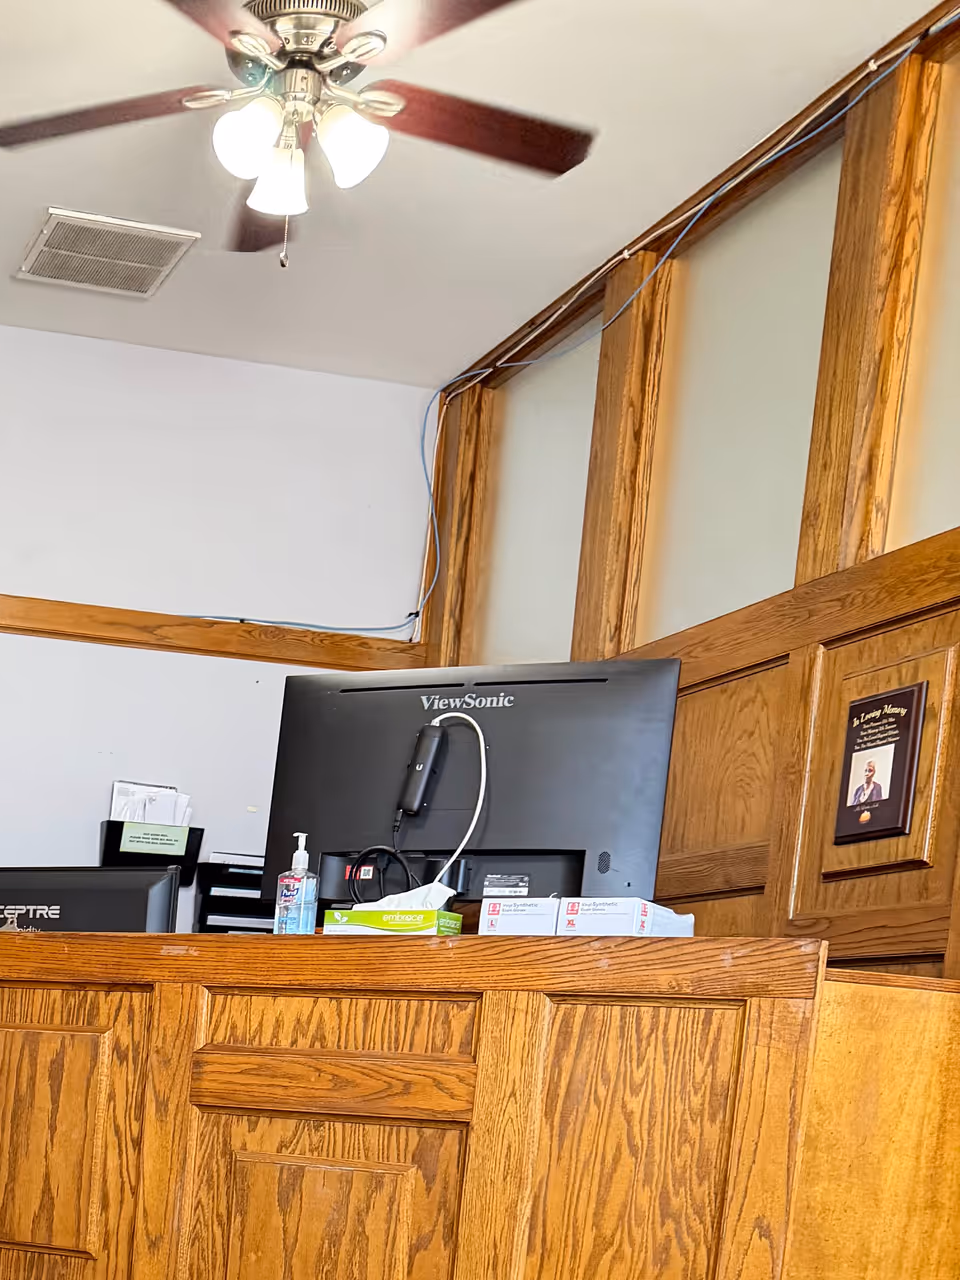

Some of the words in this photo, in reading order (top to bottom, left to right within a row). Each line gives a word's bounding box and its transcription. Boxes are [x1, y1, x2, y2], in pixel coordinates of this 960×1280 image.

[420, 692, 515, 710] ViewSonic
[860, 709, 882, 723] Loving
[882, 704, 908, 717] Memory
[382, 911, 424, 922] embrace
